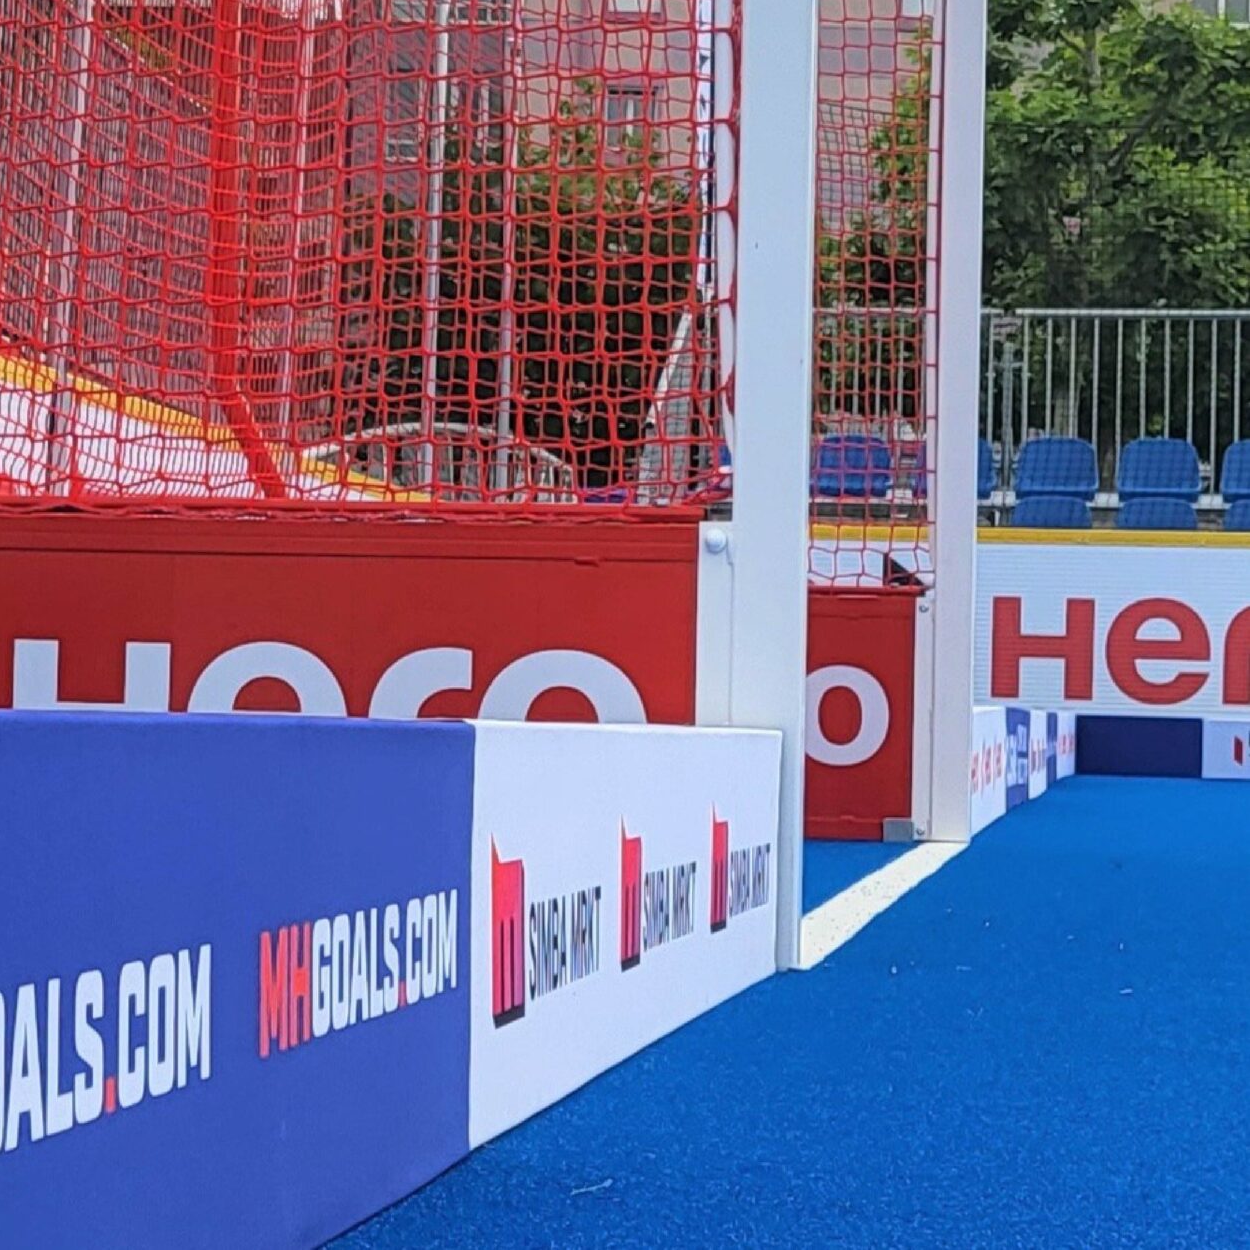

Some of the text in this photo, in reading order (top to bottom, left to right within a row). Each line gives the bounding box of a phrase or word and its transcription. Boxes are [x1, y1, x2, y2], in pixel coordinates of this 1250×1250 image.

[259, 889, 458, 1059] MHGOALS.COM
[529, 885, 601, 1001] SIMBA MRKT
